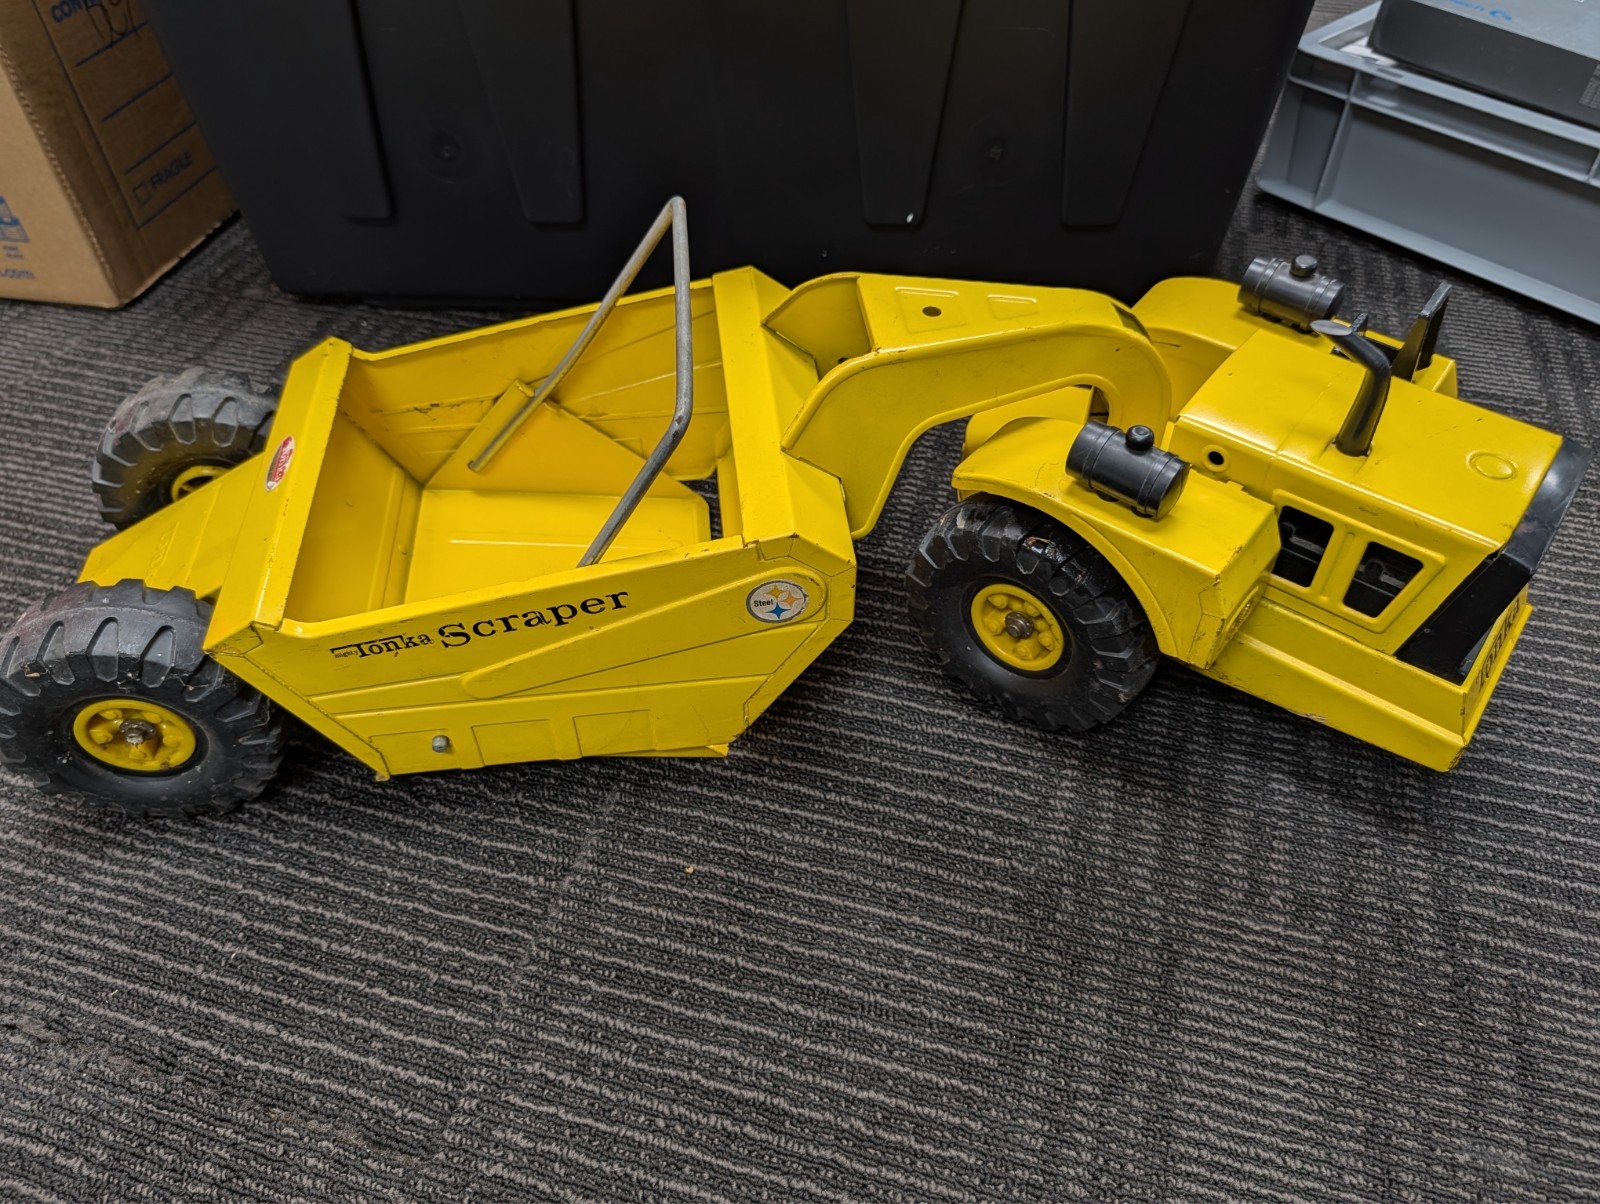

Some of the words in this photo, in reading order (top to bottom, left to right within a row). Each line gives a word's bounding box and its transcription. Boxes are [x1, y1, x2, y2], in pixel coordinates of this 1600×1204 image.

[150, 150, 193, 188] FRAGILE
[753, 598, 774, 607] Steel
[334, 649, 358, 659] mighty
[352, 633, 434, 658] Tonka
[437, 591, 629, 648] Scraper
